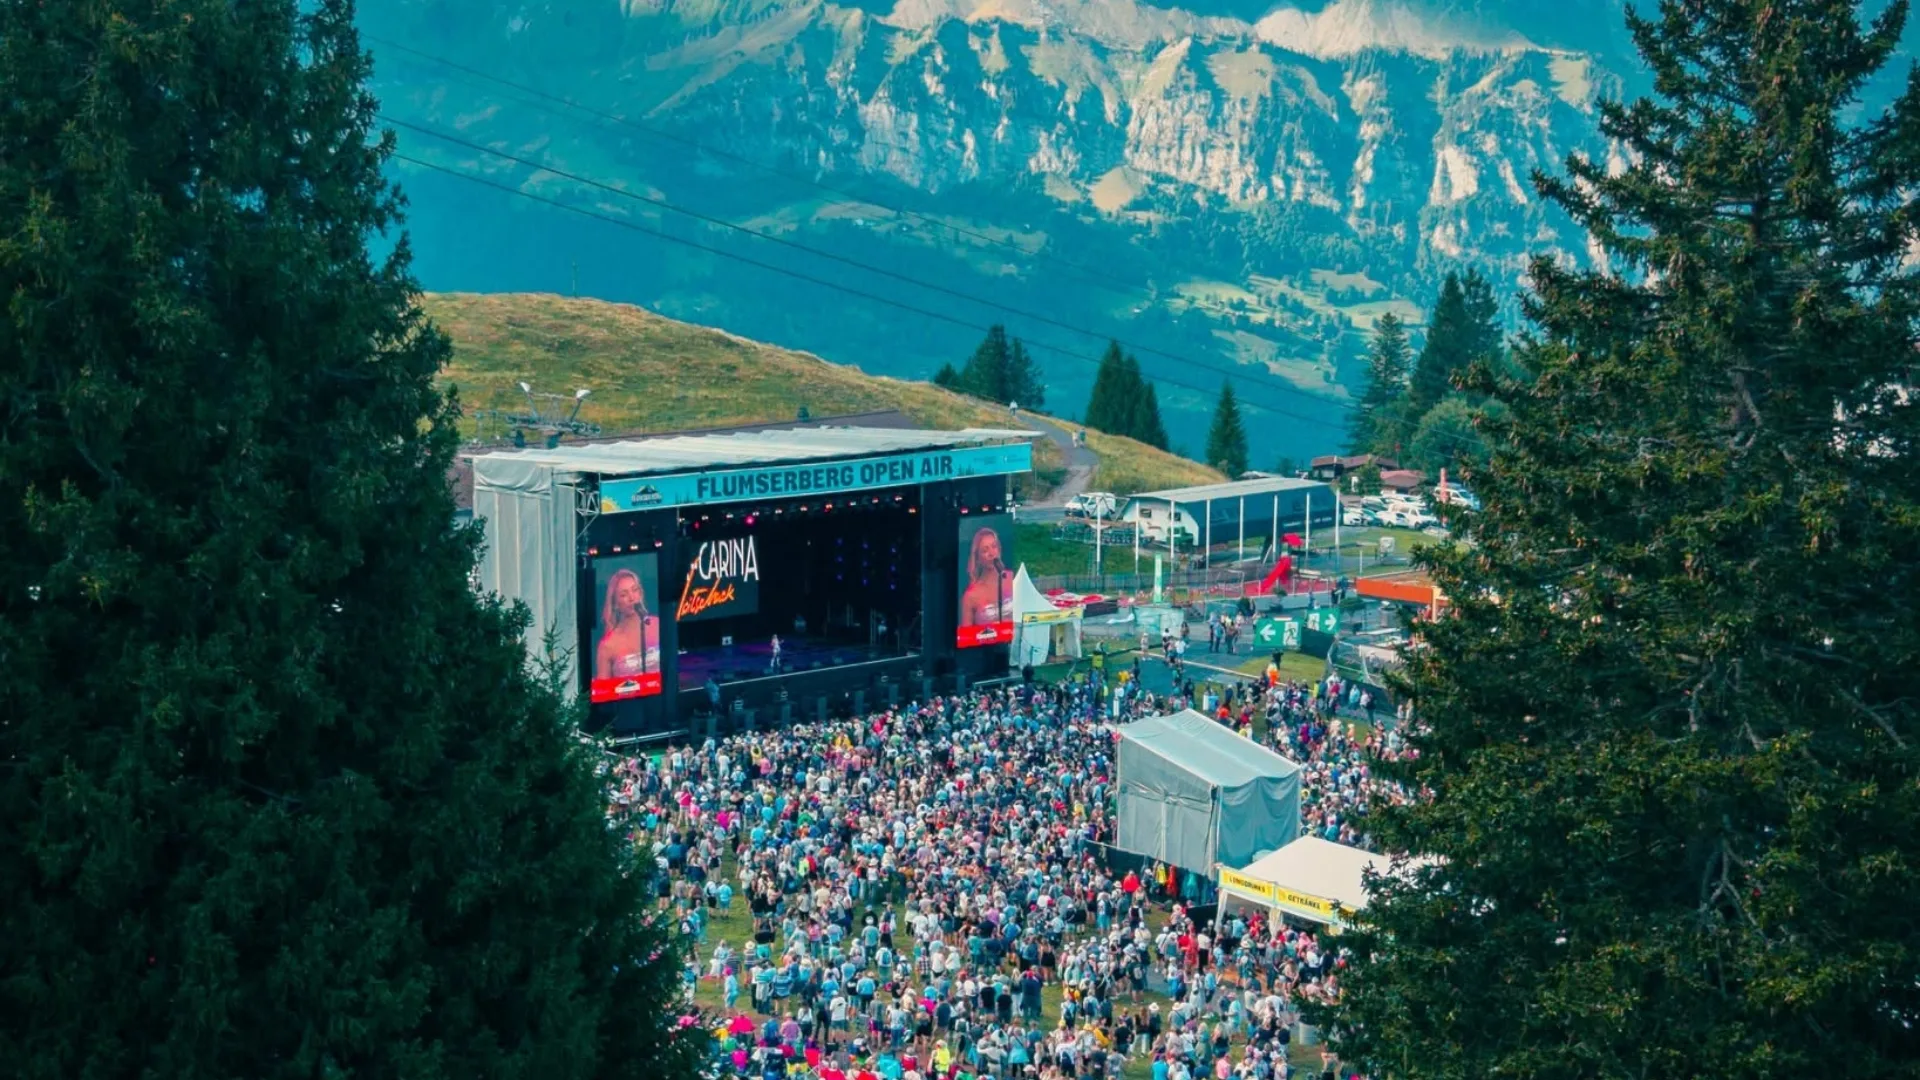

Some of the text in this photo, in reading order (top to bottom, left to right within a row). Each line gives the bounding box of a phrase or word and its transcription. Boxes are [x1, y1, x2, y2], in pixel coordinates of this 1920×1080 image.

[697, 456, 953, 499] FLUMSERBERG OPEN AIR
[699, 534, 759, 582] CARINA
